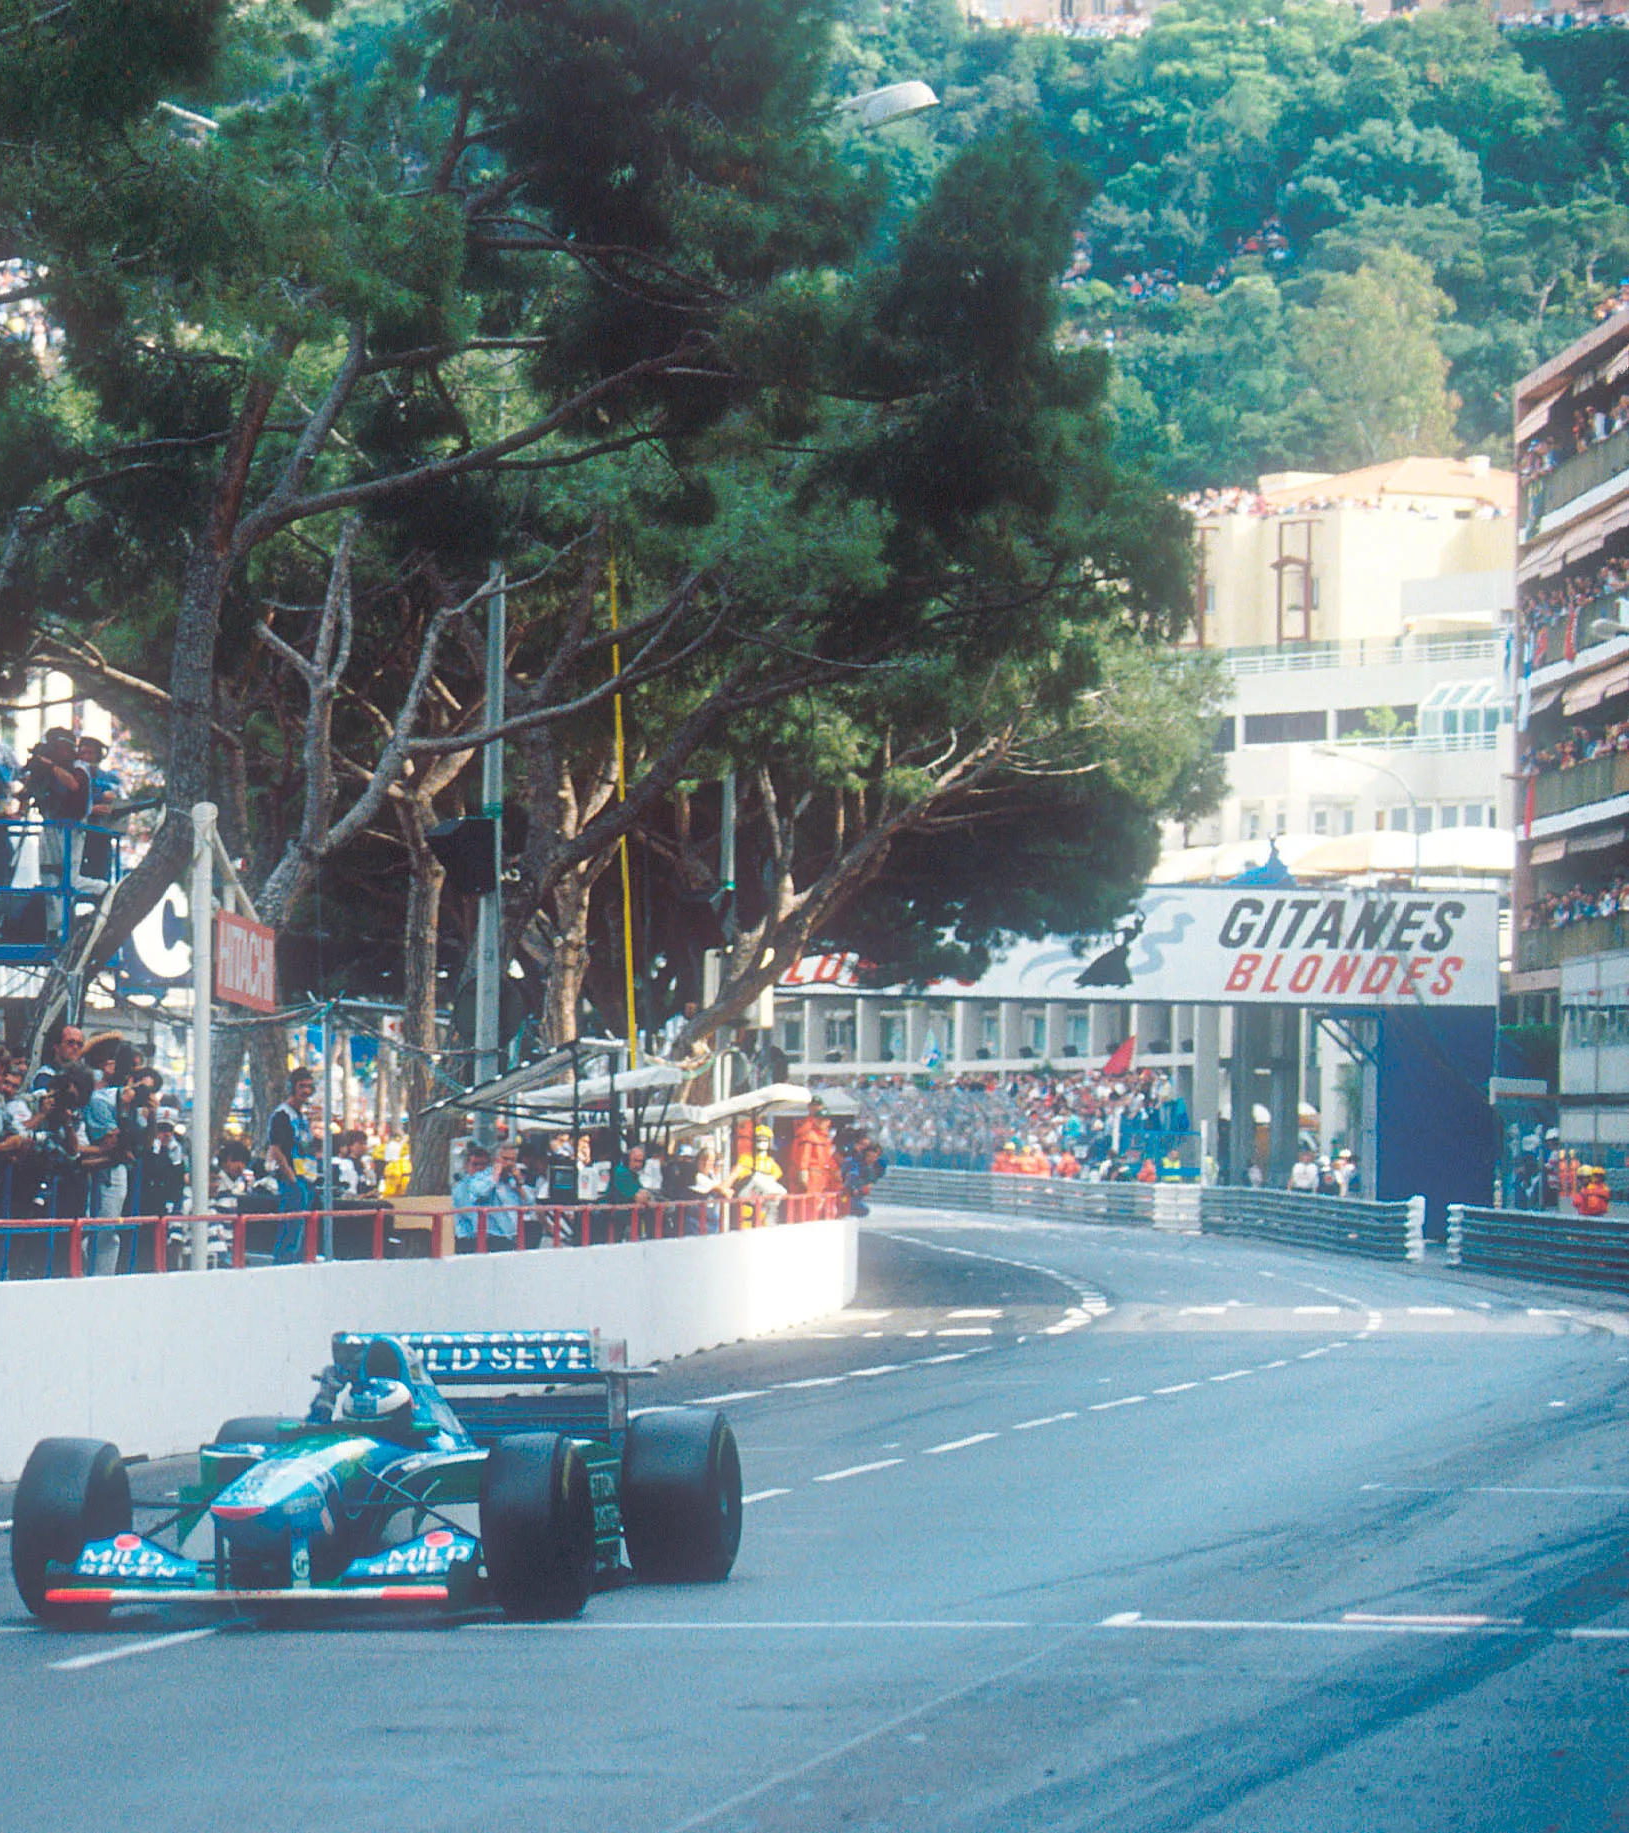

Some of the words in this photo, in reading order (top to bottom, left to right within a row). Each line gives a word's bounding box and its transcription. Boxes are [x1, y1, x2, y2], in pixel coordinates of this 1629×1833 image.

[1218, 898, 1467, 952] GITANES
[218, 919, 275, 1003] HITACHI
[1224, 953, 1465, 996] BLONDES
[489, 1347, 596, 1371] SEVE
[82, 1548, 165, 1566] MILD
[388, 1545, 470, 1563] MILD
